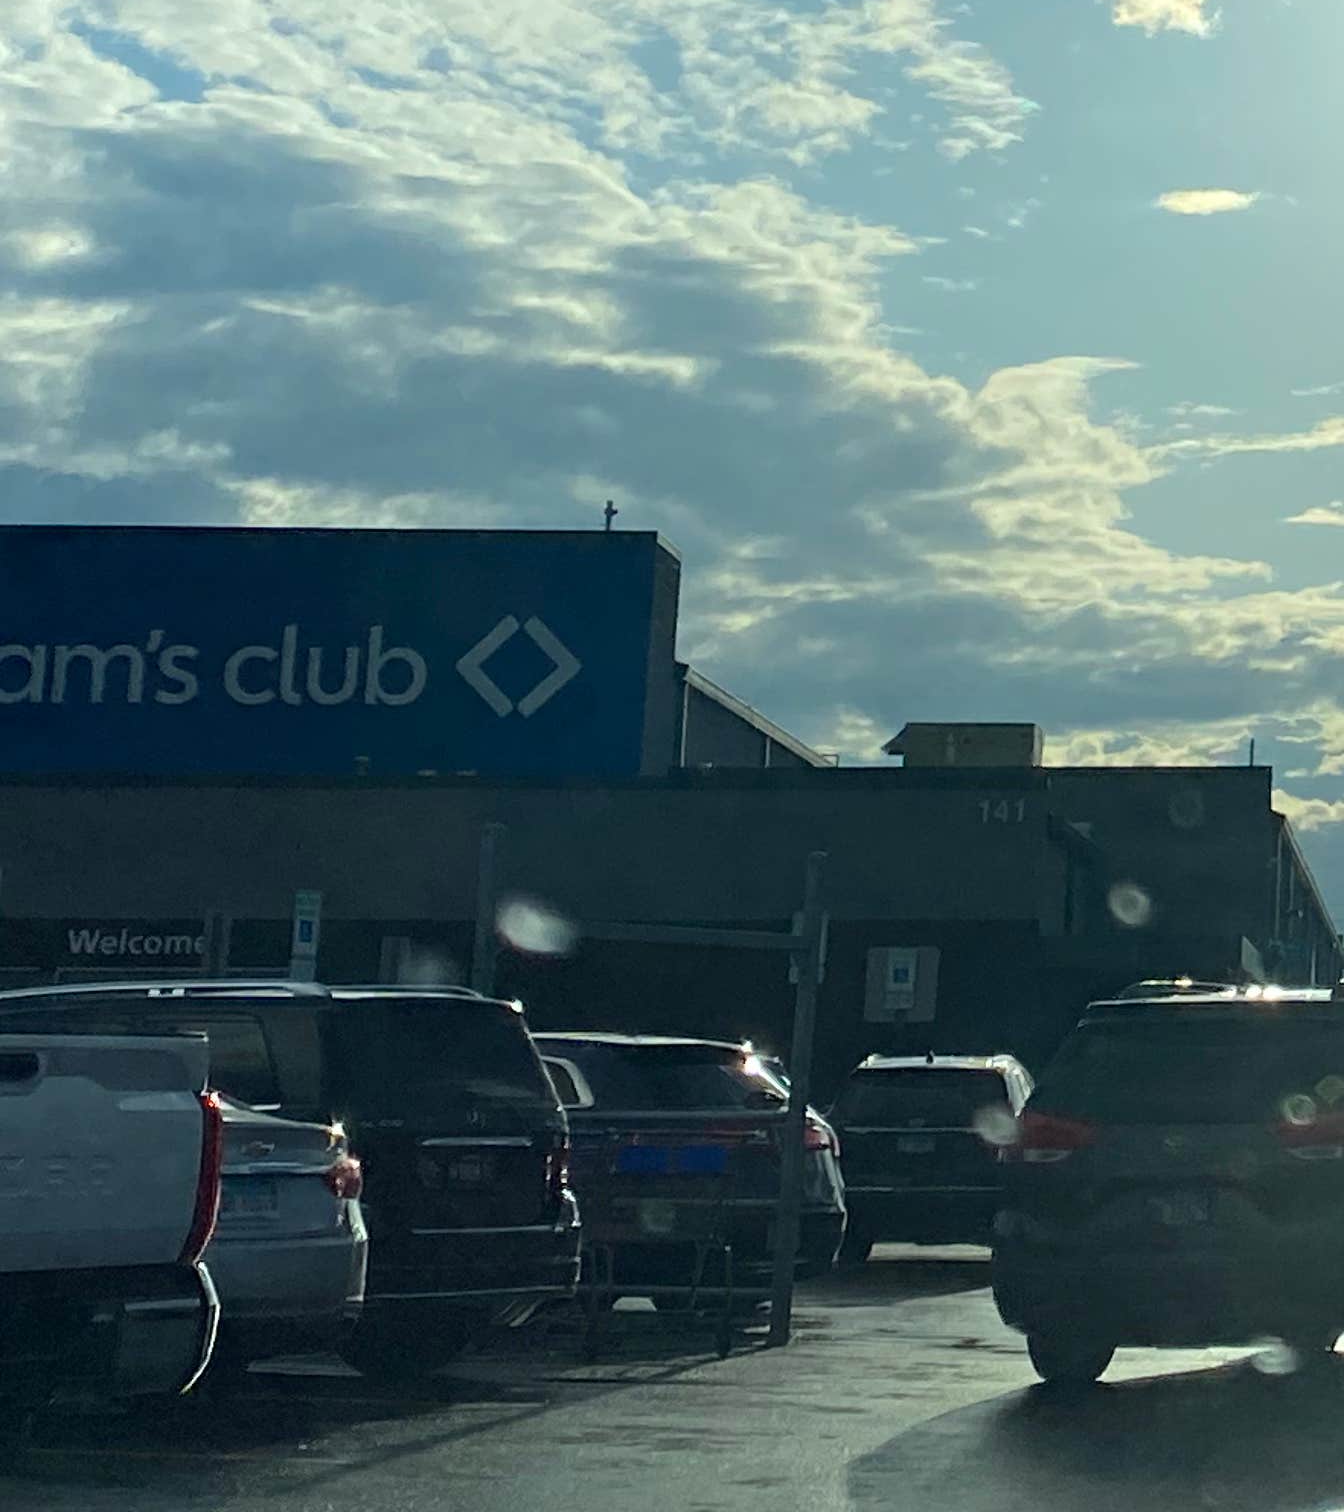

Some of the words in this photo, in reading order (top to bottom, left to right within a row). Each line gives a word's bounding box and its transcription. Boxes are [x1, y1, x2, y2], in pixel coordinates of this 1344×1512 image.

[0, 628, 200, 705] am's
[223, 623, 428, 706] club
[977, 797, 1026, 825] 141
